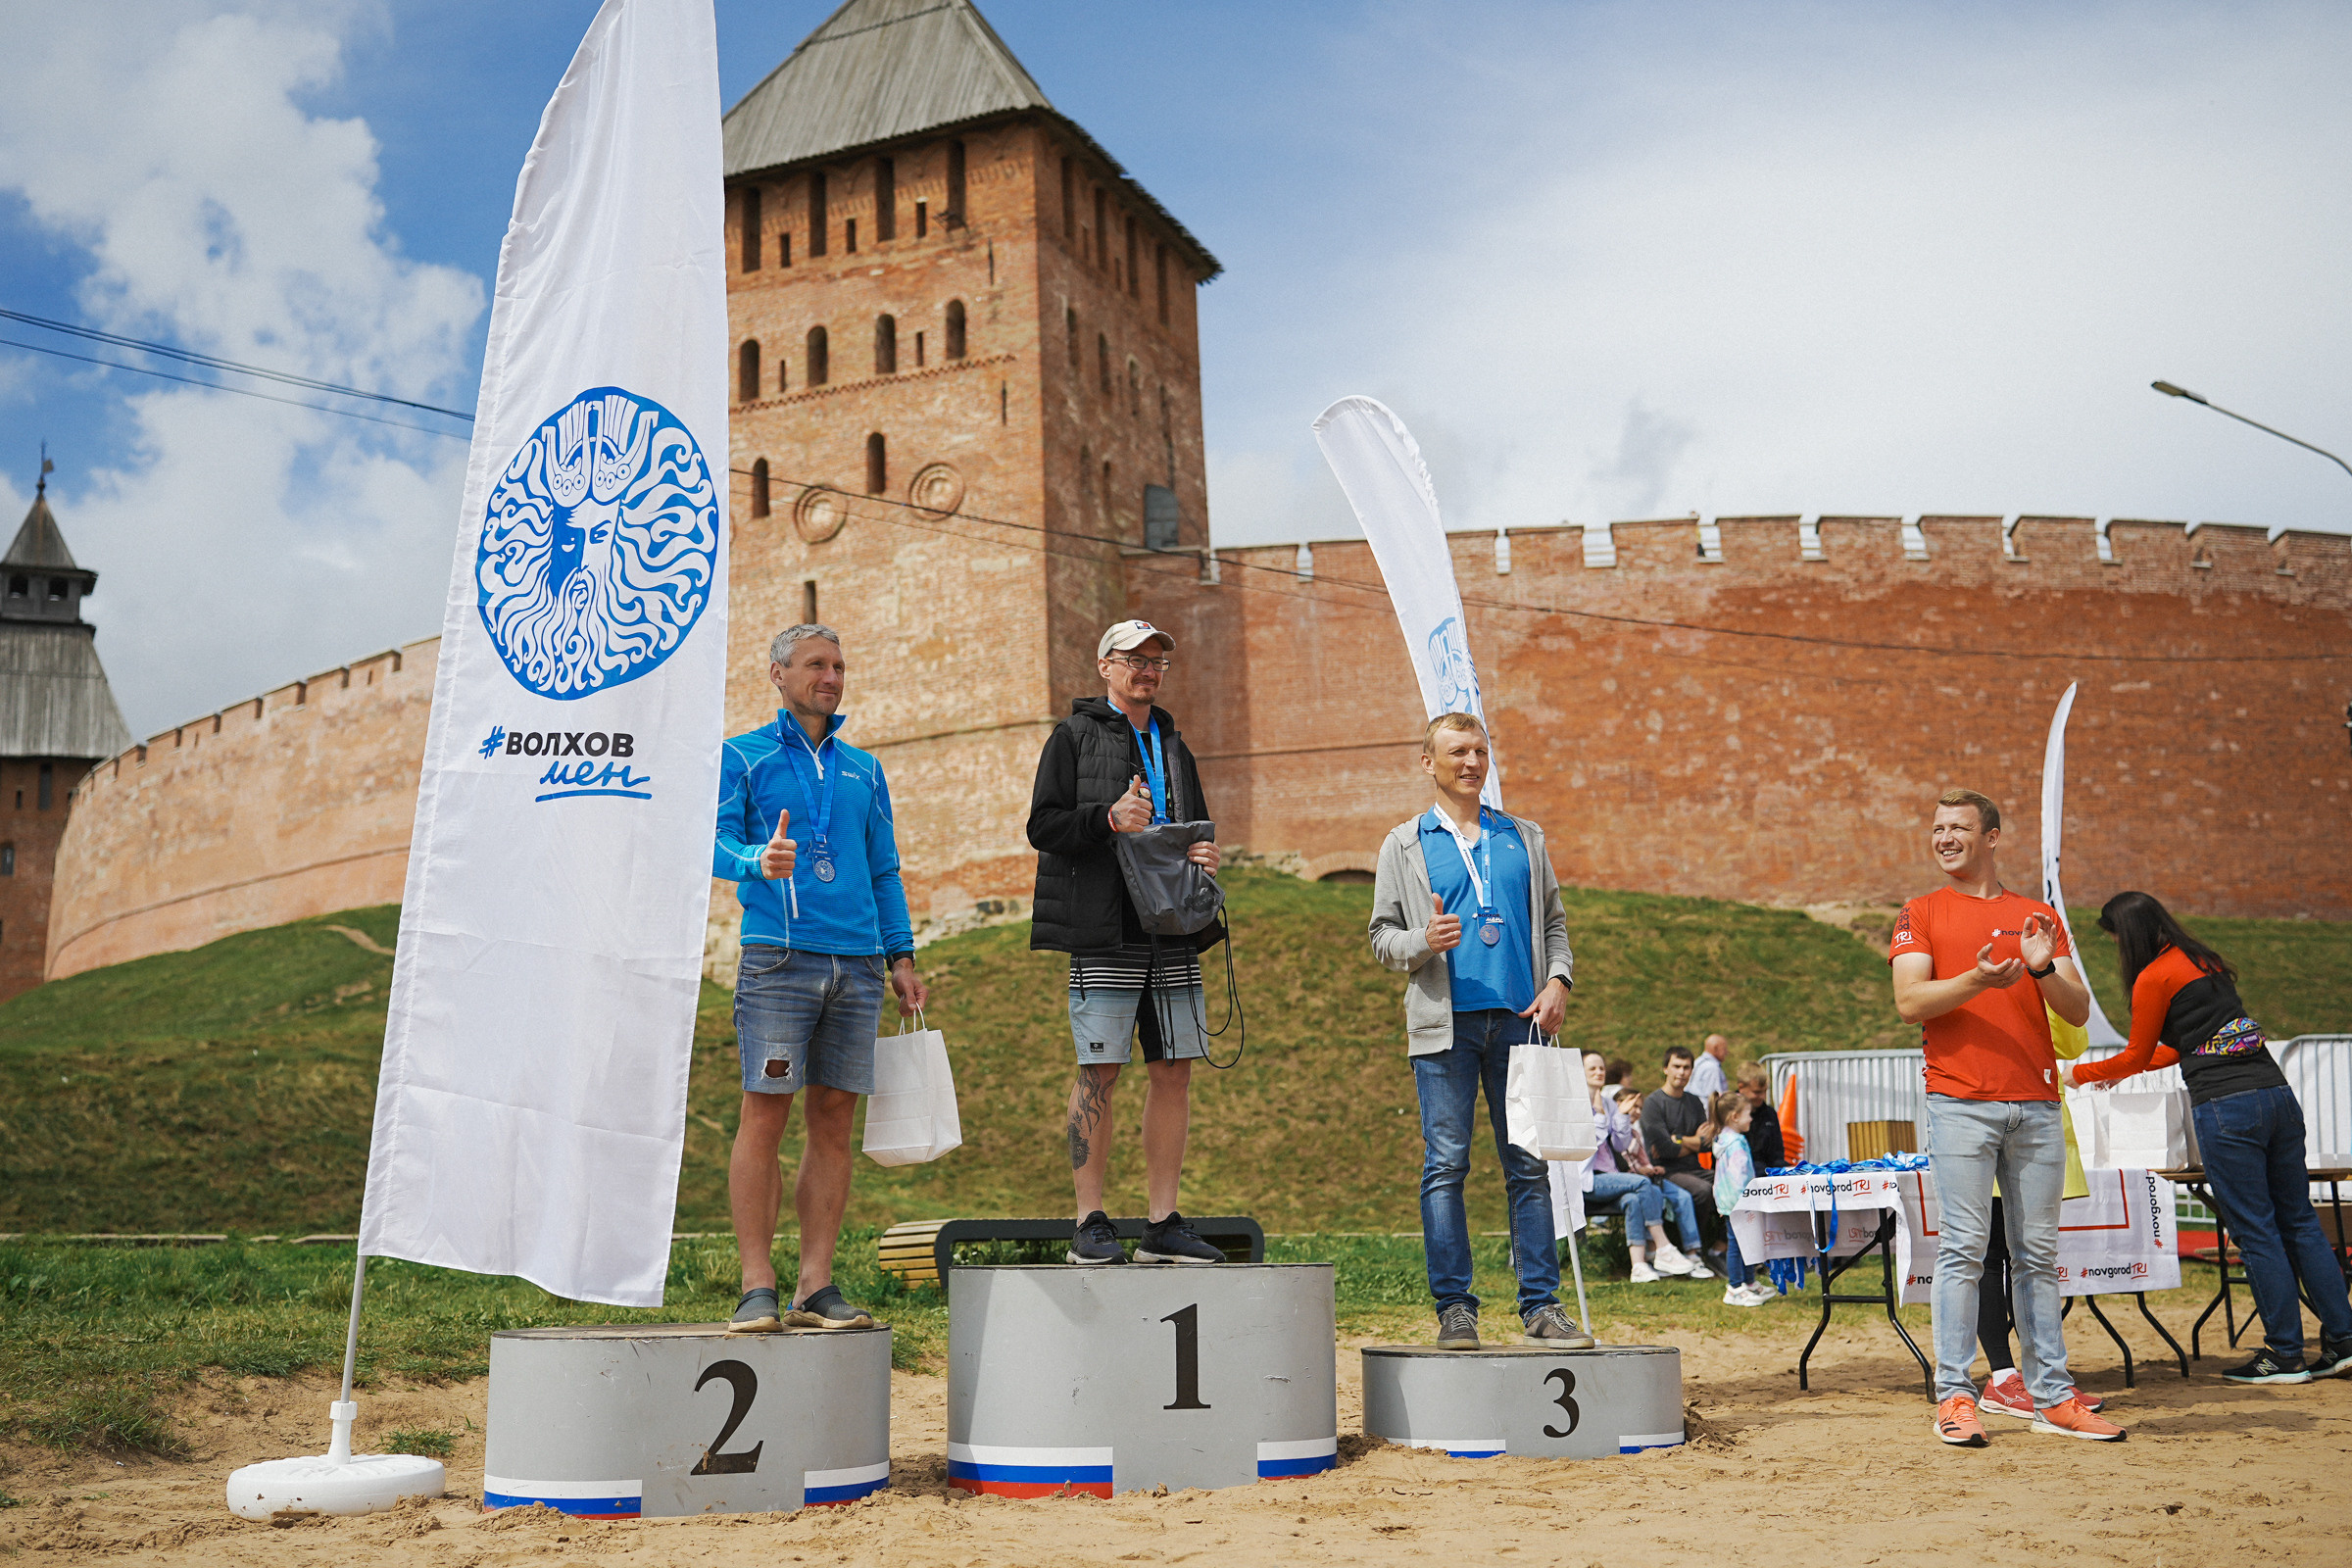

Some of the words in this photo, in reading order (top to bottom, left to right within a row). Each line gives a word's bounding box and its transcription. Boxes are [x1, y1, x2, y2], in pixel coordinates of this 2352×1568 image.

[478, 725, 634, 760] #ВОЛХОВ
[539, 760, 651, 788] мен
[1160, 1303, 1211, 1409] 1
[691, 1359, 763, 1475] 2
[1543, 1367, 1581, 1439] 3
